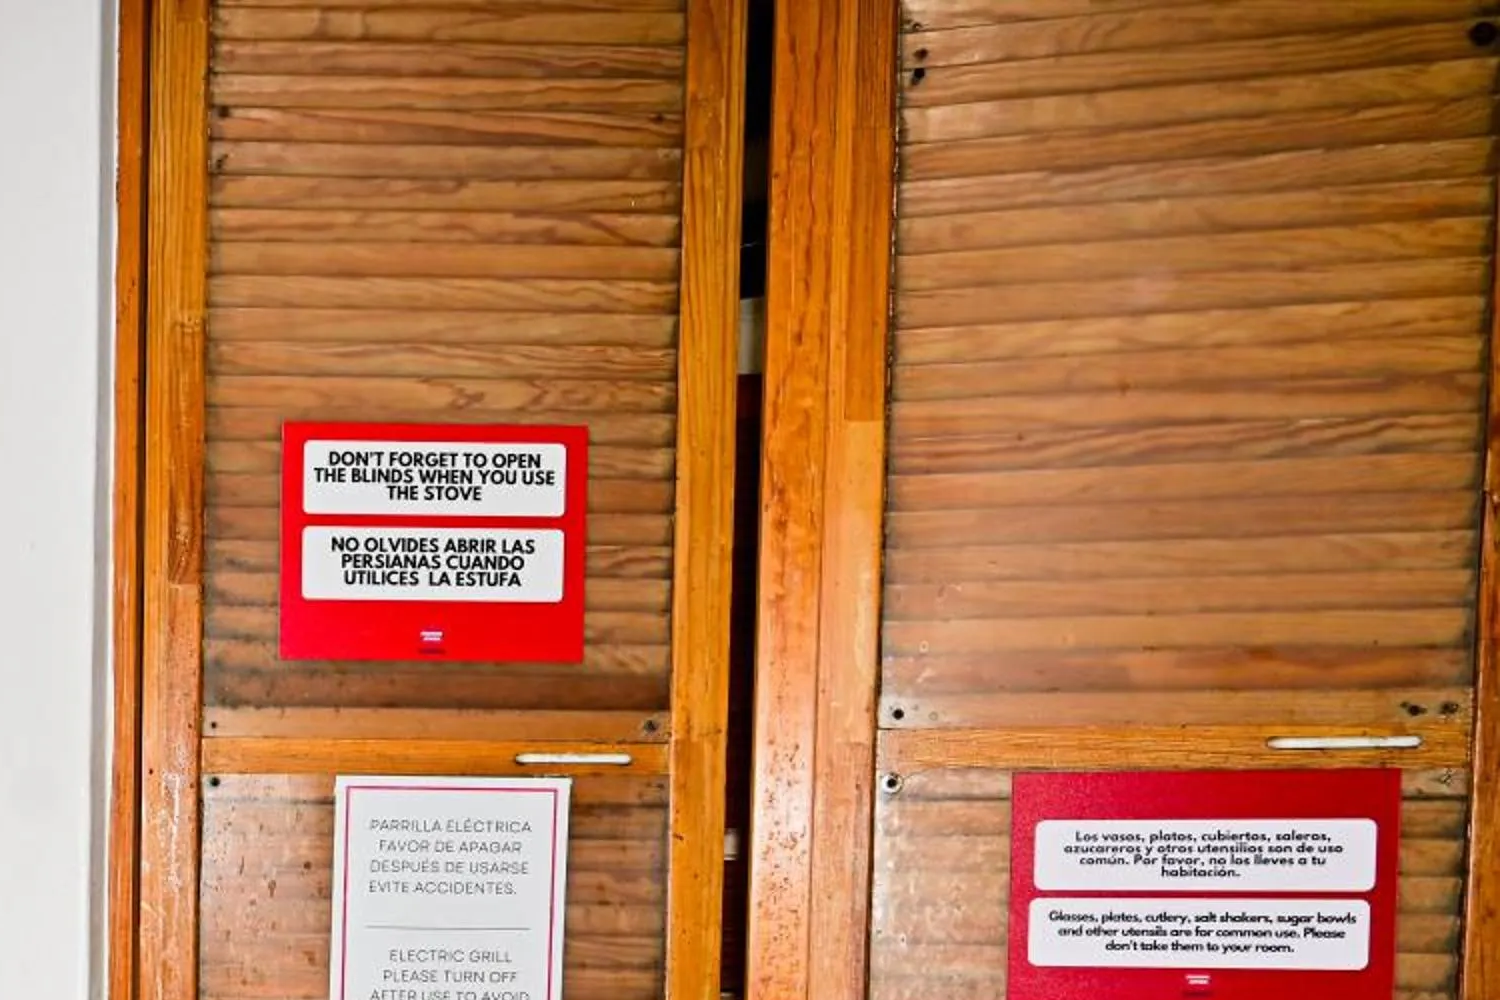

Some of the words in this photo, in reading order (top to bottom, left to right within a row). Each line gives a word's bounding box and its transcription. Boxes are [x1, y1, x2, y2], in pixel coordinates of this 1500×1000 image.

[329, 451, 384, 467] DON'T
[389, 452, 459, 467] FORGET
[463, 453, 488, 468] TO
[492, 453, 542, 469] OPEN
[313, 467, 346, 483] THE
[352, 468, 414, 484] BLINDS
[419, 469, 474, 485] WHEN
[478, 470, 517, 485] YOU
[522, 470, 555, 486] USE
[386, 485, 419, 501] THE
[424, 486, 483, 501] STOVE
[331, 536, 360, 552] NO
[364, 537, 439, 553] OLVIDES
[444, 538, 496, 554] ABRIR
[502, 539, 536, 555] LAS
[341, 554, 441, 570] PERSIANAS
[446, 555, 525, 571] CUANDO
[344, 570, 419, 586] UTILICES
[428, 571, 451, 587] LA
[455, 571, 522, 587] ESTUFA
[369, 819, 442, 833] PARRILLA
[447, 817, 532, 833] ELÉCTRICA
[1075, 830, 1099, 842] Los
[1102, 833, 1145, 844] vasos,
[1149, 830, 1198, 844] platos,
[1201, 830, 1271, 843] cubiertos,
[1276, 829, 1332, 843] saleros,
[379, 839, 430, 853] FAVOR
[434, 840, 455, 853] DE
[458, 840, 522, 854] APAGAR
[1063, 844, 1141, 854] azucareros
[1144, 845, 1154, 856] y
[1157, 843, 1194, 854] otros
[1197, 842, 1263, 854] utensilios
[1267, 845, 1292, 853] son
[1296, 842, 1314, 853] de
[1318, 845, 1344, 853] uso
[370, 857, 440, 873] DESPUÉS
[444, 861, 465, 874] DE
[469, 861, 529, 875] USARSE
[1079, 853, 1130, 865] común.
[1133, 854, 1158, 865] Por
[1161, 854, 1205, 866] favor,
[1209, 857, 1227, 865] no
[1230, 854, 1250, 865] los
[1254, 854, 1294, 866] lleves
[1297, 857, 1307, 865] a
[1311, 855, 1326, 865] tu
[1161, 866, 1240, 877] habitación.
[369, 880, 409, 894] EVITE
[414, 881, 517, 895] ACCIDENTES.
[1049, 910, 1099, 923] Glasses,
[1101, 911, 1142, 924] plates,
[1145, 911, 1191, 925] cutlery,
[1194, 912, 1216, 923] salt
[1219, 912, 1273, 924] shakers,
[1277, 914, 1314, 926] sugar
[1317, 912, 1357, 924] bowls
[1058, 925, 1083, 936] and
[1086, 926, 1118, 937] other
[1121, 926, 1168, 937] utensils
[1170, 928, 1192, 937] are
[1195, 926, 1214, 937] for
[1216, 929, 1273, 938] common
[1275, 930, 1300, 939] use.
[1303, 928, 1346, 939] Please
[1105, 940, 1138, 951] don't
[1140, 941, 1167, 951] take
[1171, 941, 1204, 952] them
[1207, 942, 1220, 952] to
[1221, 944, 1251, 954] your
[1255, 944, 1294, 953] room.
[389, 949, 465, 963] ELECTRIC
[468, 950, 512, 964] GRILL
[383, 969, 438, 983] PLEASE
[443, 970, 485, 984] TURN
[489, 971, 517, 984] OFF
